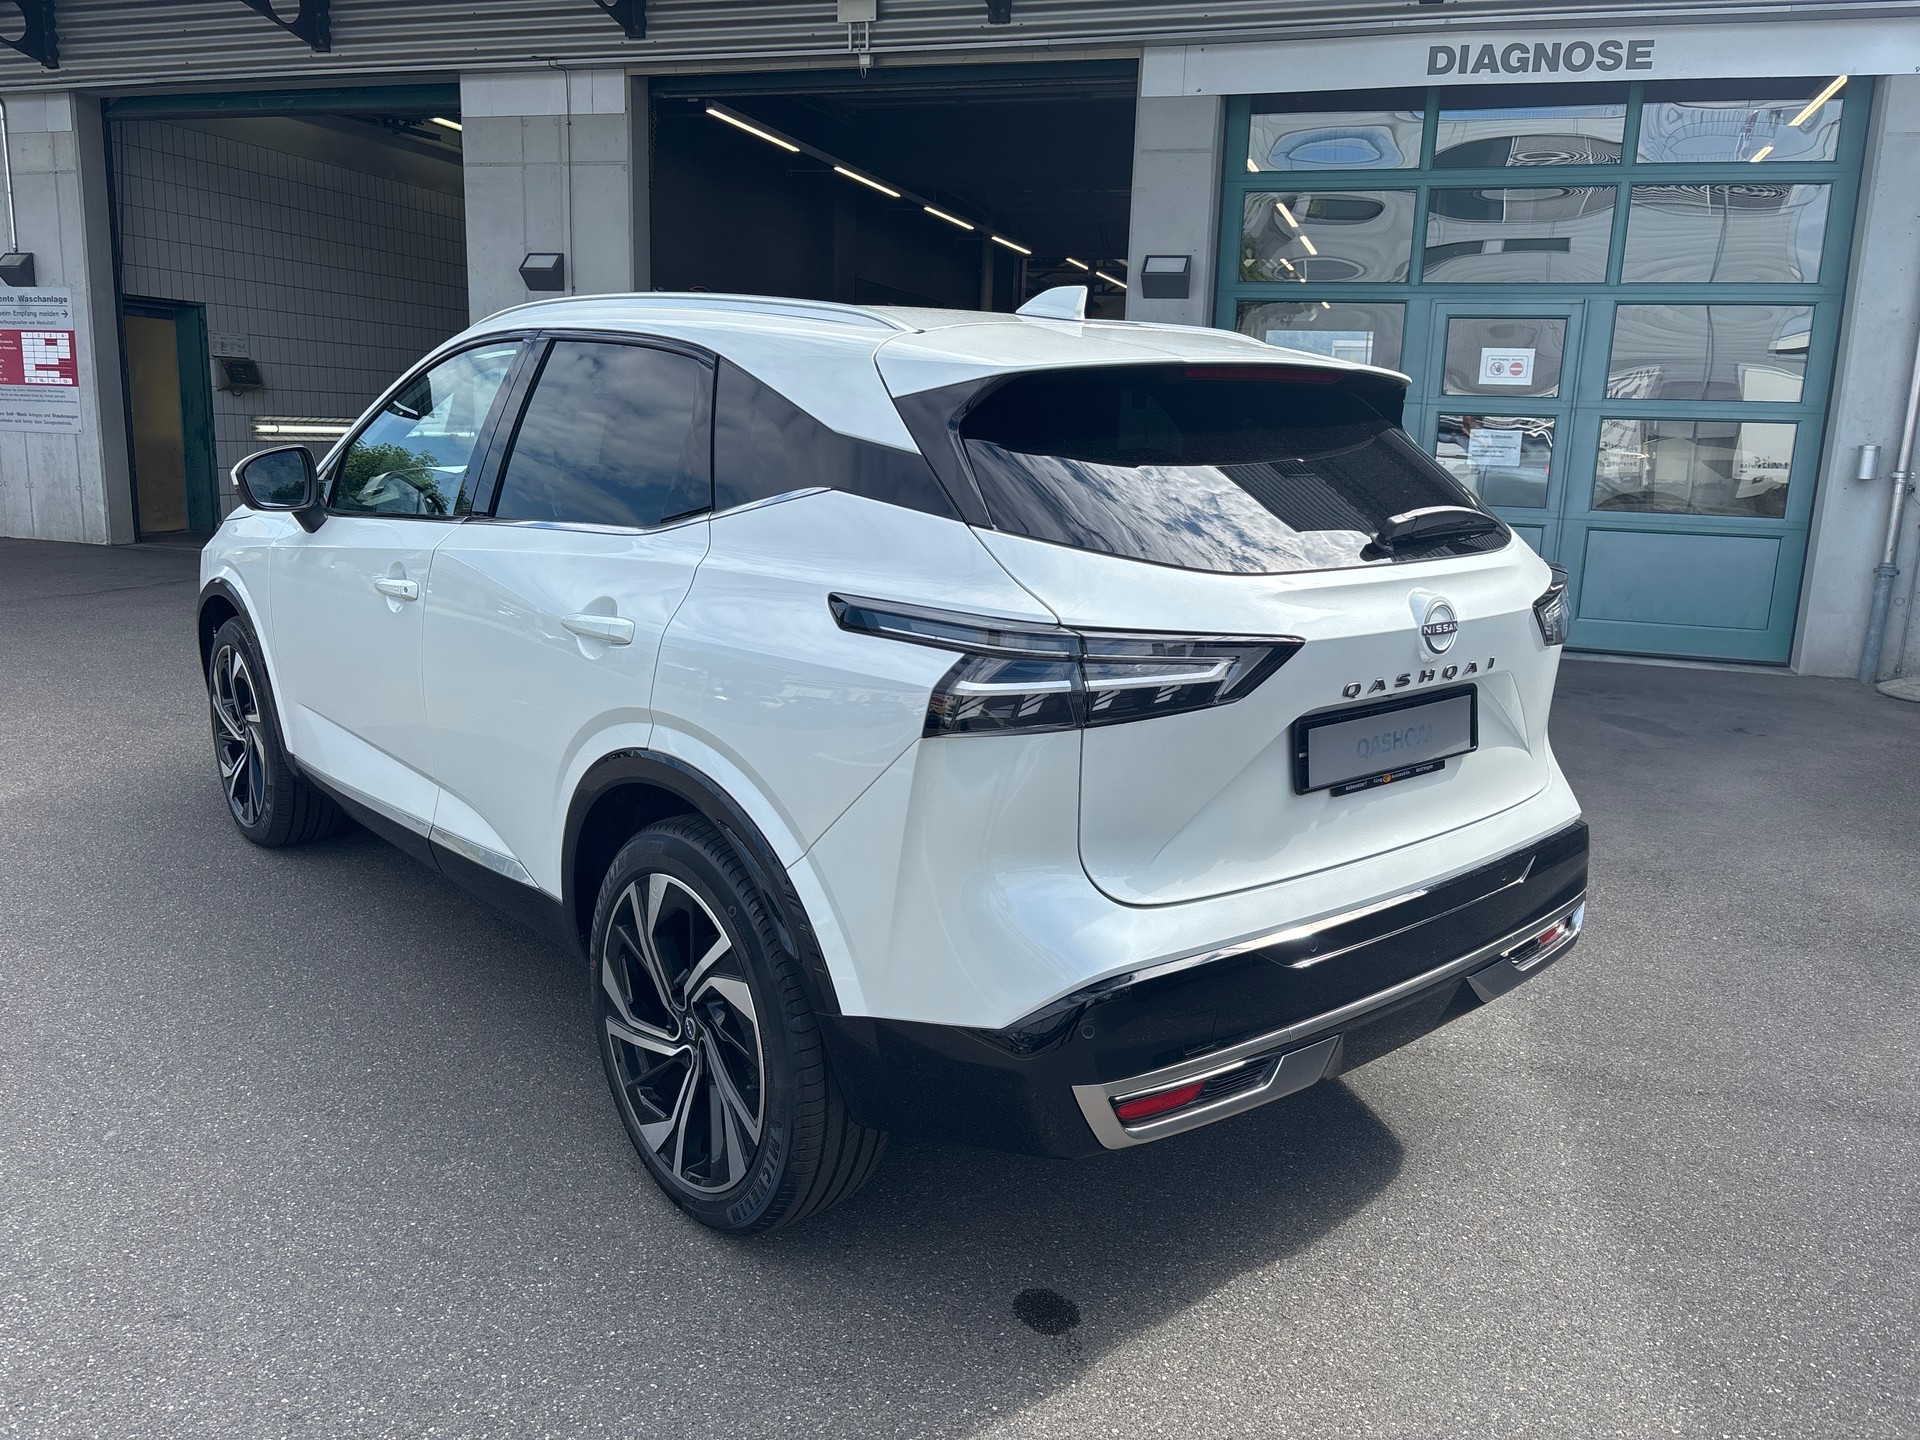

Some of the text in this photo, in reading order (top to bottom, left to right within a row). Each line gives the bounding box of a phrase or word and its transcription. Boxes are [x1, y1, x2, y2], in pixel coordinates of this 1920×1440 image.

[1427, 39, 1655, 76] DIAGNOSE
[17, 294, 68, 304] Waschanlage
[12, 310, 37, 318] Empfang
[1423, 621, 1458, 635] NISSAN
[1342, 656, 1496, 698] QASHQAI
[731, 1134, 781, 1222] MICHELIN
